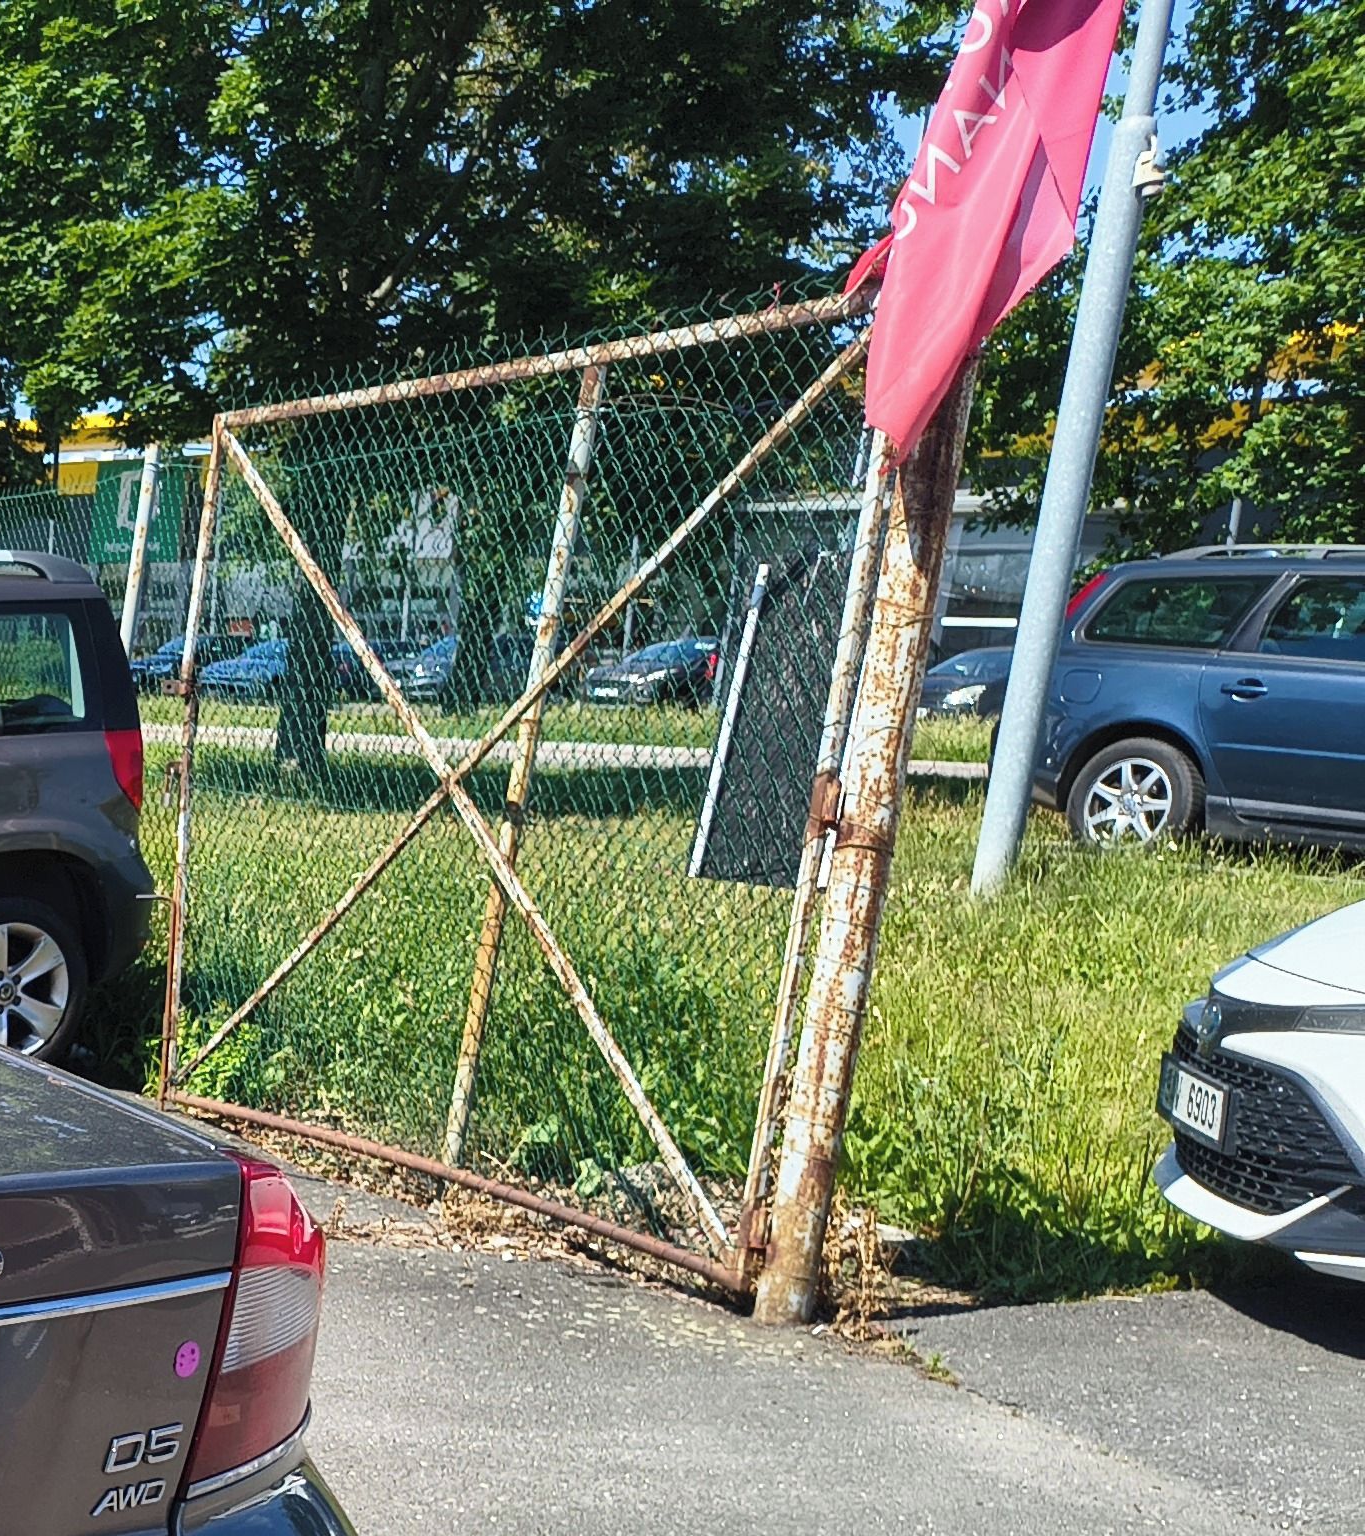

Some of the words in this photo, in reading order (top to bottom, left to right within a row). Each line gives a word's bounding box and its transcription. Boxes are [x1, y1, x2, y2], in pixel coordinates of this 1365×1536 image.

[1186, 1082, 1217, 1130] 6903
[103, 1422, 184, 1474] D5
[89, 1478, 167, 1518] AWD
